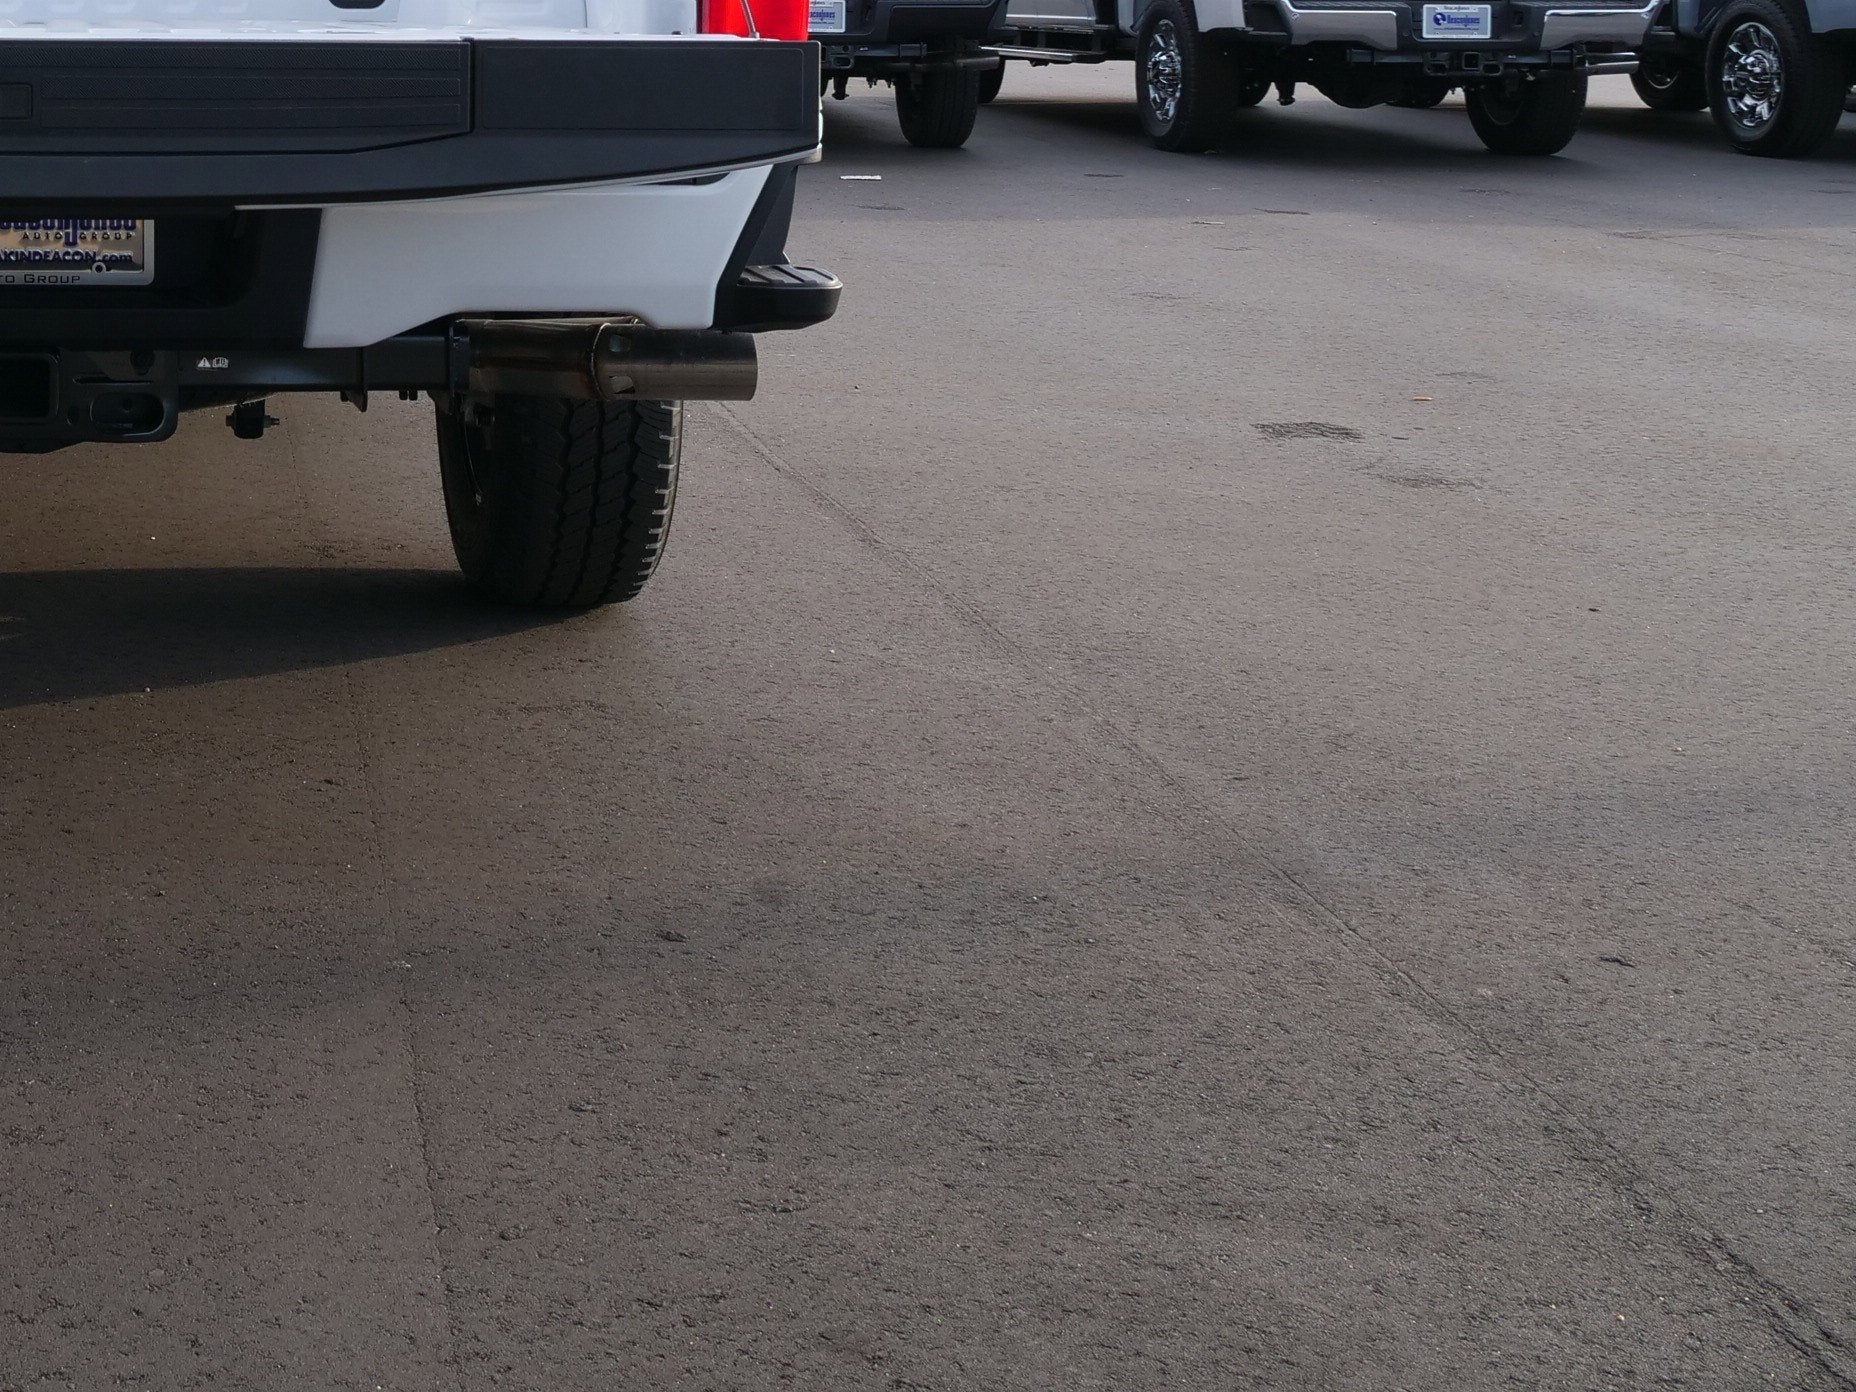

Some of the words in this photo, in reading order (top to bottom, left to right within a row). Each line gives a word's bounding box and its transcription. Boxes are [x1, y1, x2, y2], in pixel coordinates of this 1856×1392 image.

[22, 231, 63, 241] AUTO
[79, 231, 135, 241] GROUP
[24, 272, 81, 284] GROUP
